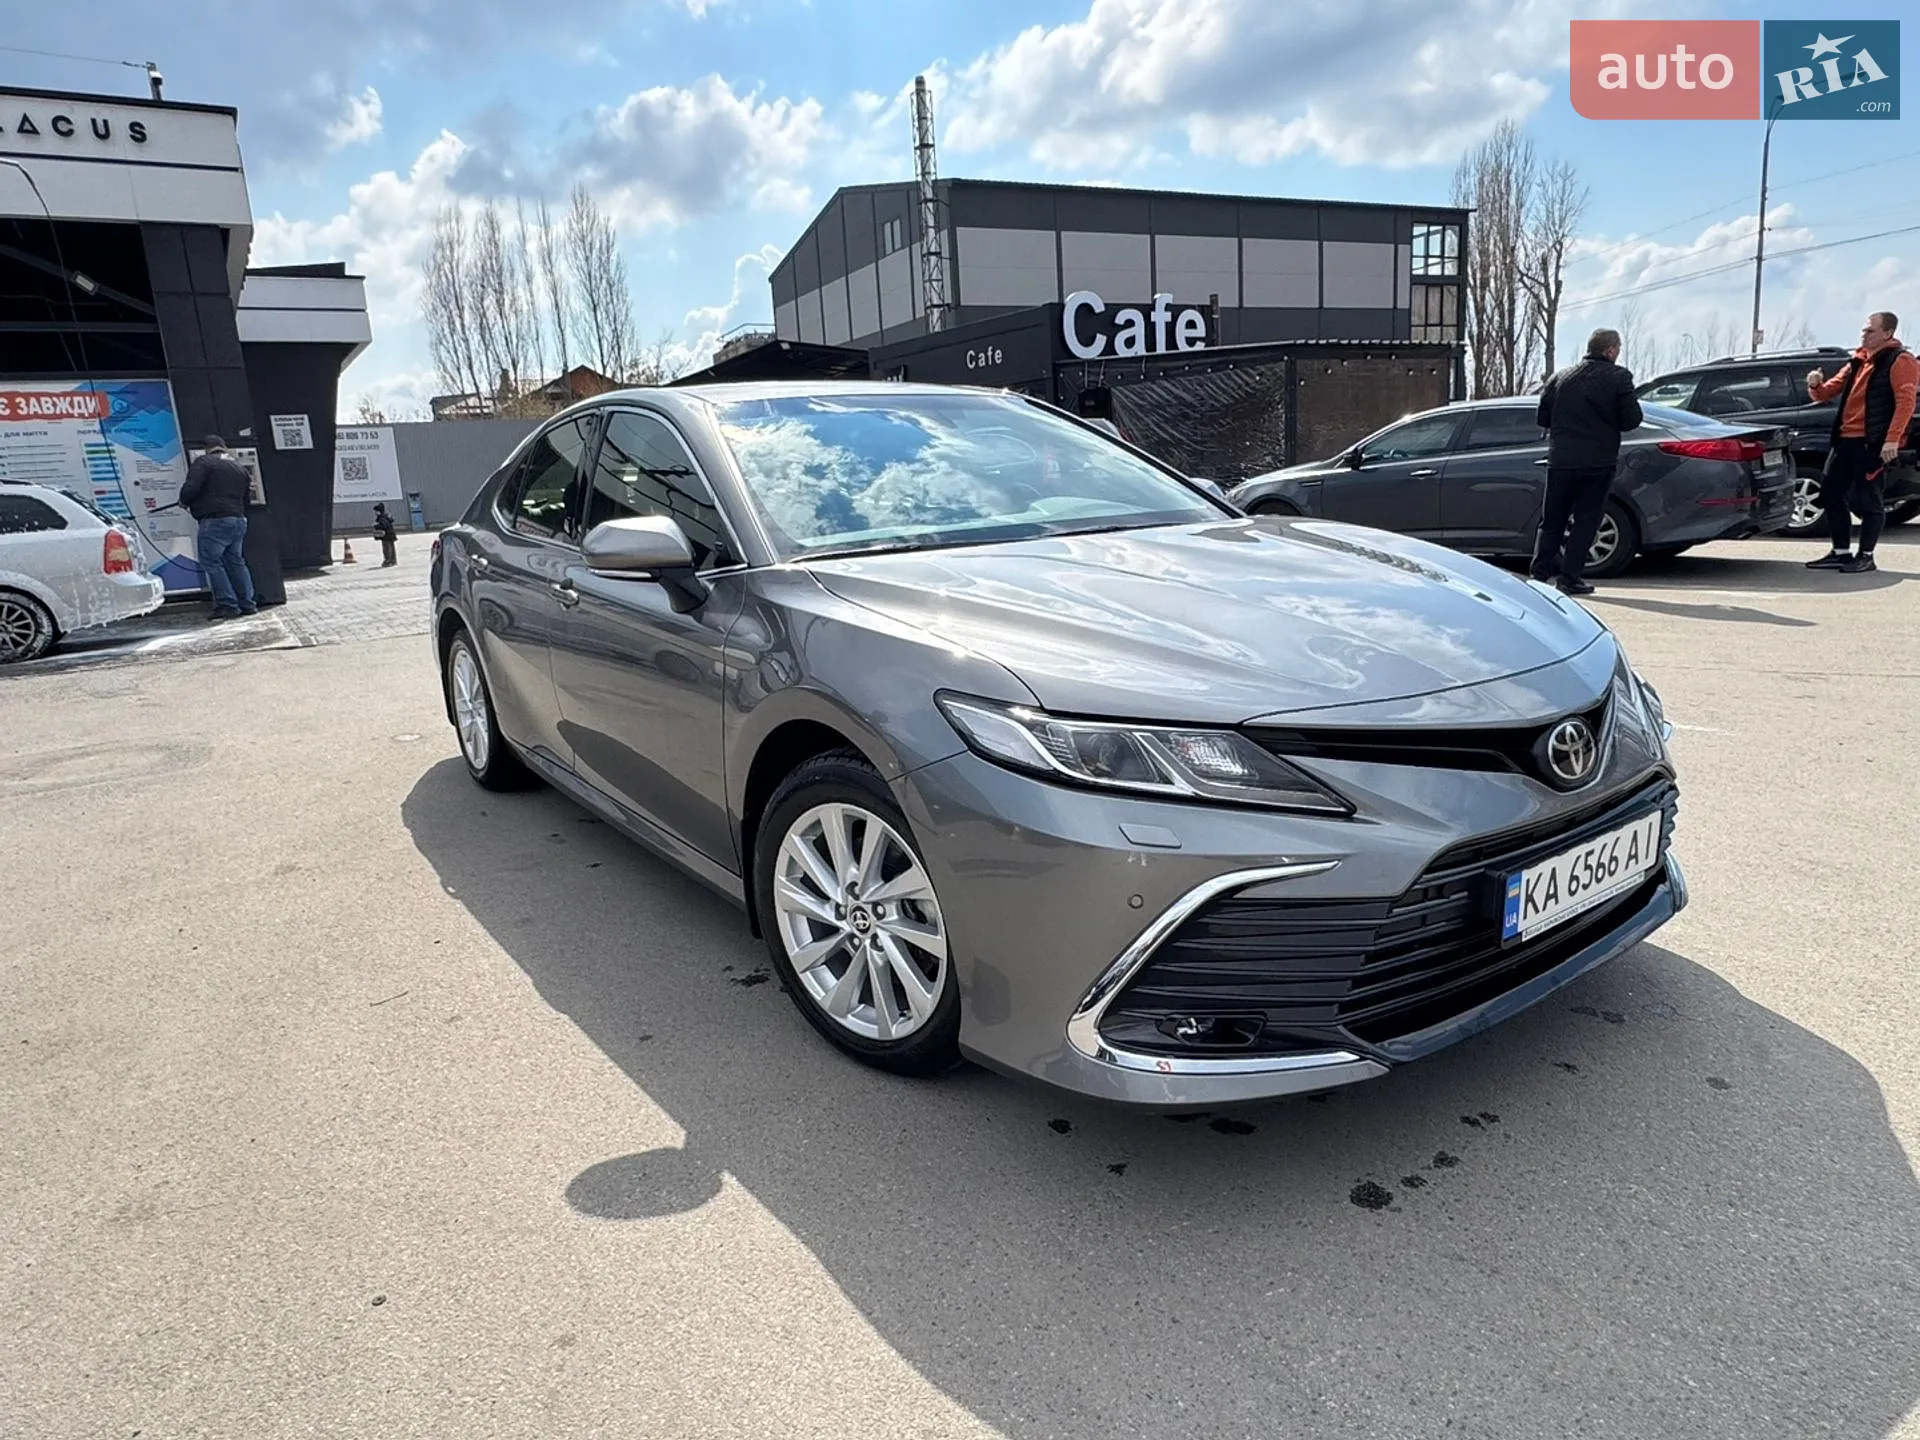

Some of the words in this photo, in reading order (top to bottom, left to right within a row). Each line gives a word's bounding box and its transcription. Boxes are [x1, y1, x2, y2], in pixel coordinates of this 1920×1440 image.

[0, 111, 148, 143] ACUS
[1063, 290, 1207, 360] Cafe
[966, 346, 1003, 369] Cafe
[15, 396, 100, 417] ЗАВЖДИ
[1523, 867, 1560, 921] KA
[1568, 836, 1622, 898] 6566
[1625, 821, 1653, 871] AI
[1505, 911, 1517, 928] UA
